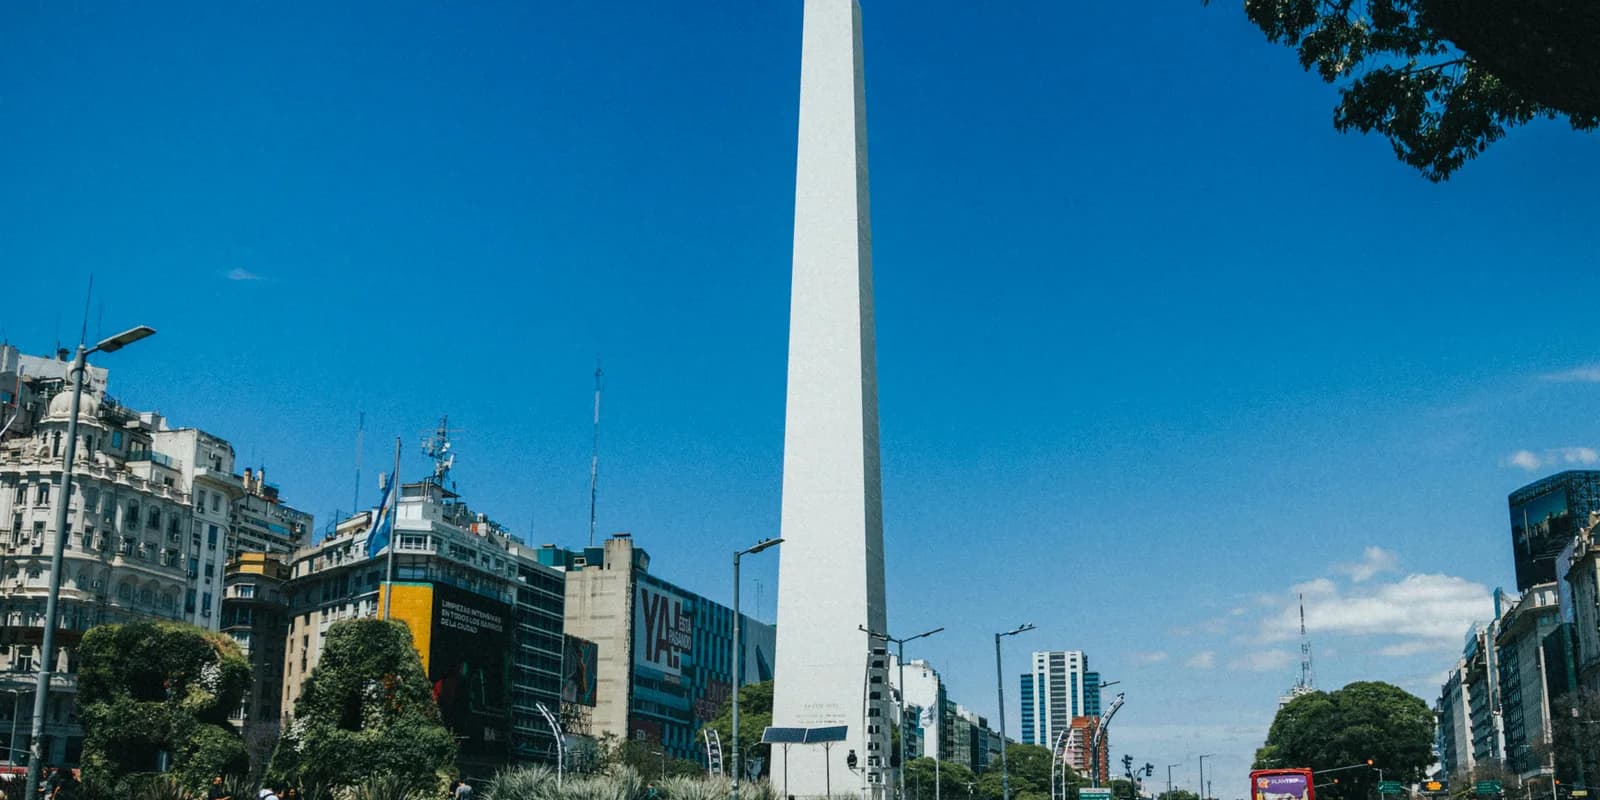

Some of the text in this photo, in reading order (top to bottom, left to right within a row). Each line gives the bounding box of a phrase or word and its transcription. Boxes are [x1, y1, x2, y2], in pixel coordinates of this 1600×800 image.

[440, 617, 478, 633] DE LA CIUDAD
[441, 608, 449, 617] EN
[450, 611, 469, 623] TODOS
[641, 588, 680, 669] YA!
[669, 627, 692, 650] PASANDO
